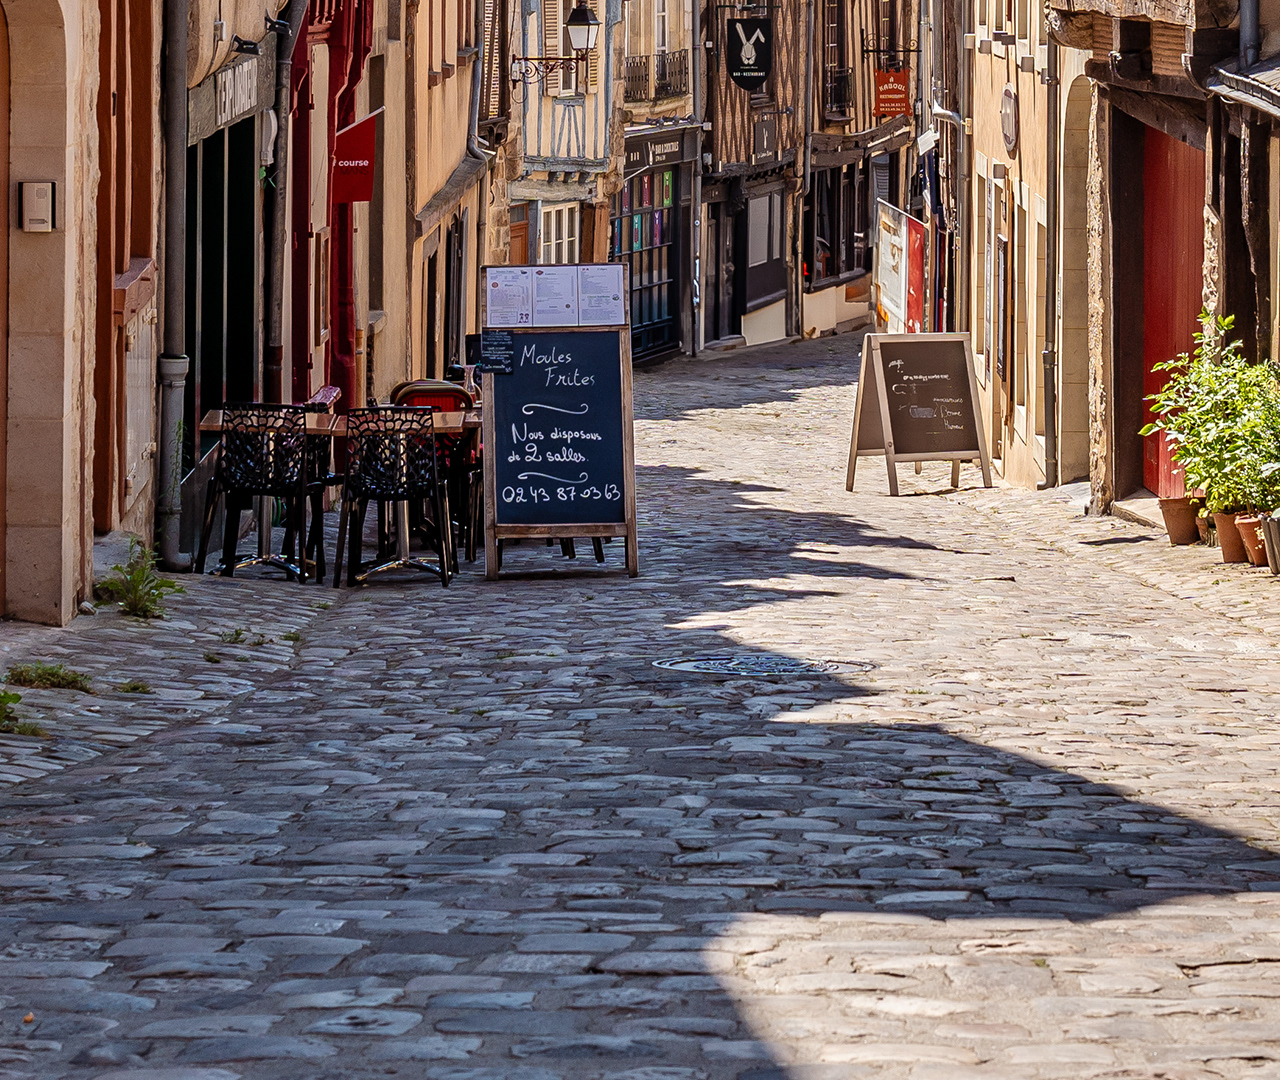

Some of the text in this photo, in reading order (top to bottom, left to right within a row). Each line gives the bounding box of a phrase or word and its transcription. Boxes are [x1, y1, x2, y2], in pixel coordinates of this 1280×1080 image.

[878, 83, 906, 92] KABOUL
[338, 159, 369, 167] course
[520, 343, 572, 367] Moules
[544, 366, 596, 387] Frites
[511, 422, 603, 444] Nous disposons
[508, 450, 521, 463] de
[524, 442, 543, 463] 2
[502, 484, 621, 504] 02 43 87 03 63
